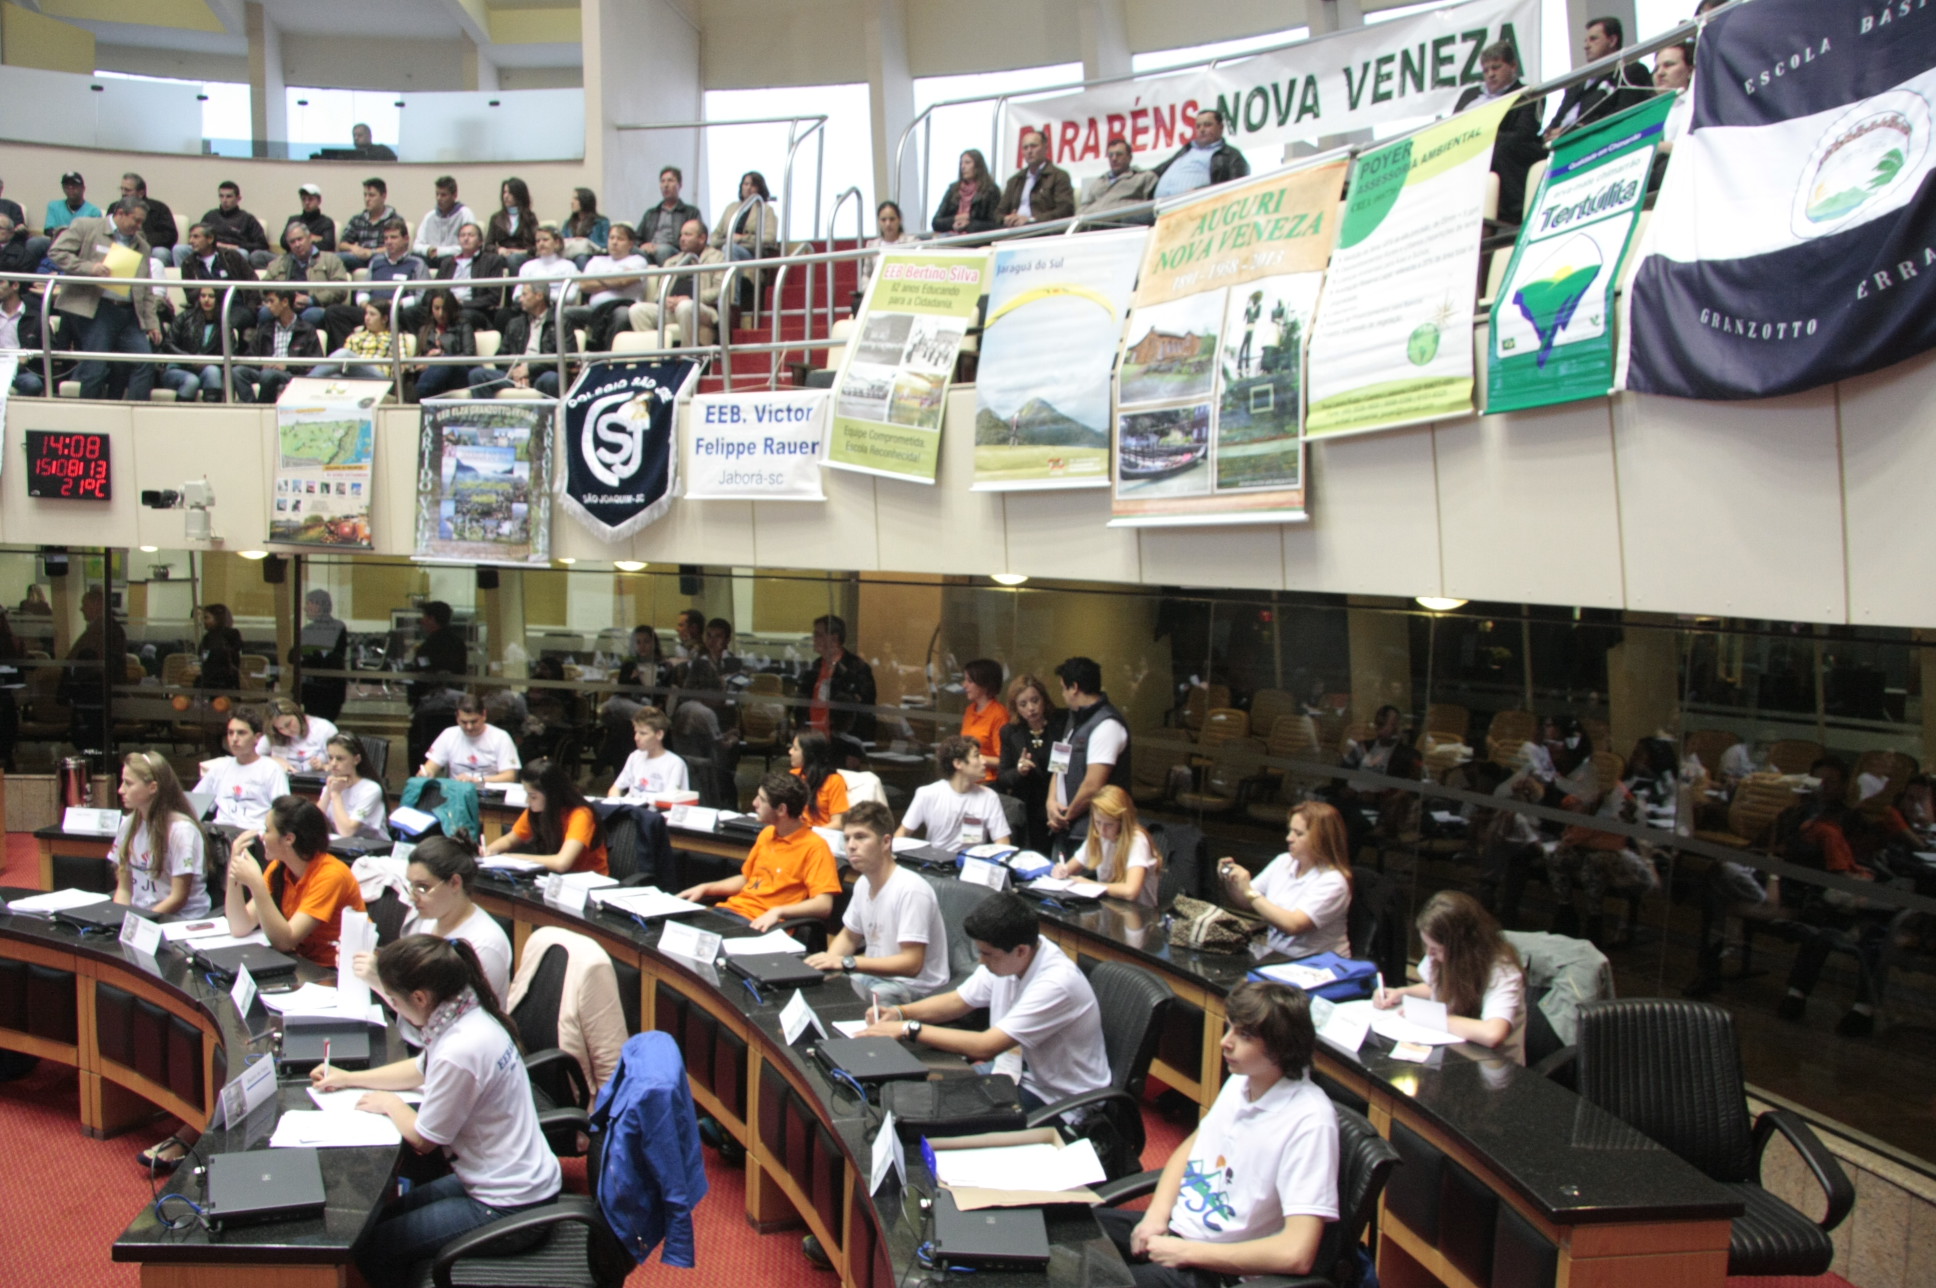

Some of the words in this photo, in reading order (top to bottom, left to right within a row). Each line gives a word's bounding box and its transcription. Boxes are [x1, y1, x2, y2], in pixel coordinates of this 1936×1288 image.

[1217, 73, 1320, 137] NOVA
[1343, 22, 1525, 111] VENEZA
[1745, 37, 1831, 95] ESCOLA
[1360, 141, 1414, 180] POYER
[1421, 127, 1482, 166] AMBIENTAL
[1191, 188, 1288, 238] AUGURI
[1541, 179, 1640, 233] Tertúlia
[1153, 236, 1215, 275] NOVA
[1218, 210, 1325, 253] VENEZA
[905, 265, 946, 281] Bertino
[950, 265, 979, 283] Silva
[996, 261, 1032, 277] Jaraguá
[1035, 259, 1047, 271] do
[1049, 257, 1064, 270] Sul
[1700, 307, 1818, 340] GRANZOTTO
[705, 404, 747, 424] EEB.
[754, 403, 814, 424] Victor
[42, 435, 101, 459] 14:08
[695, 437, 757, 460] Felippe
[763, 437, 820, 455] Rauer
[843, 425, 868, 439] Equipe
[582, 493, 599, 504] SÃO
